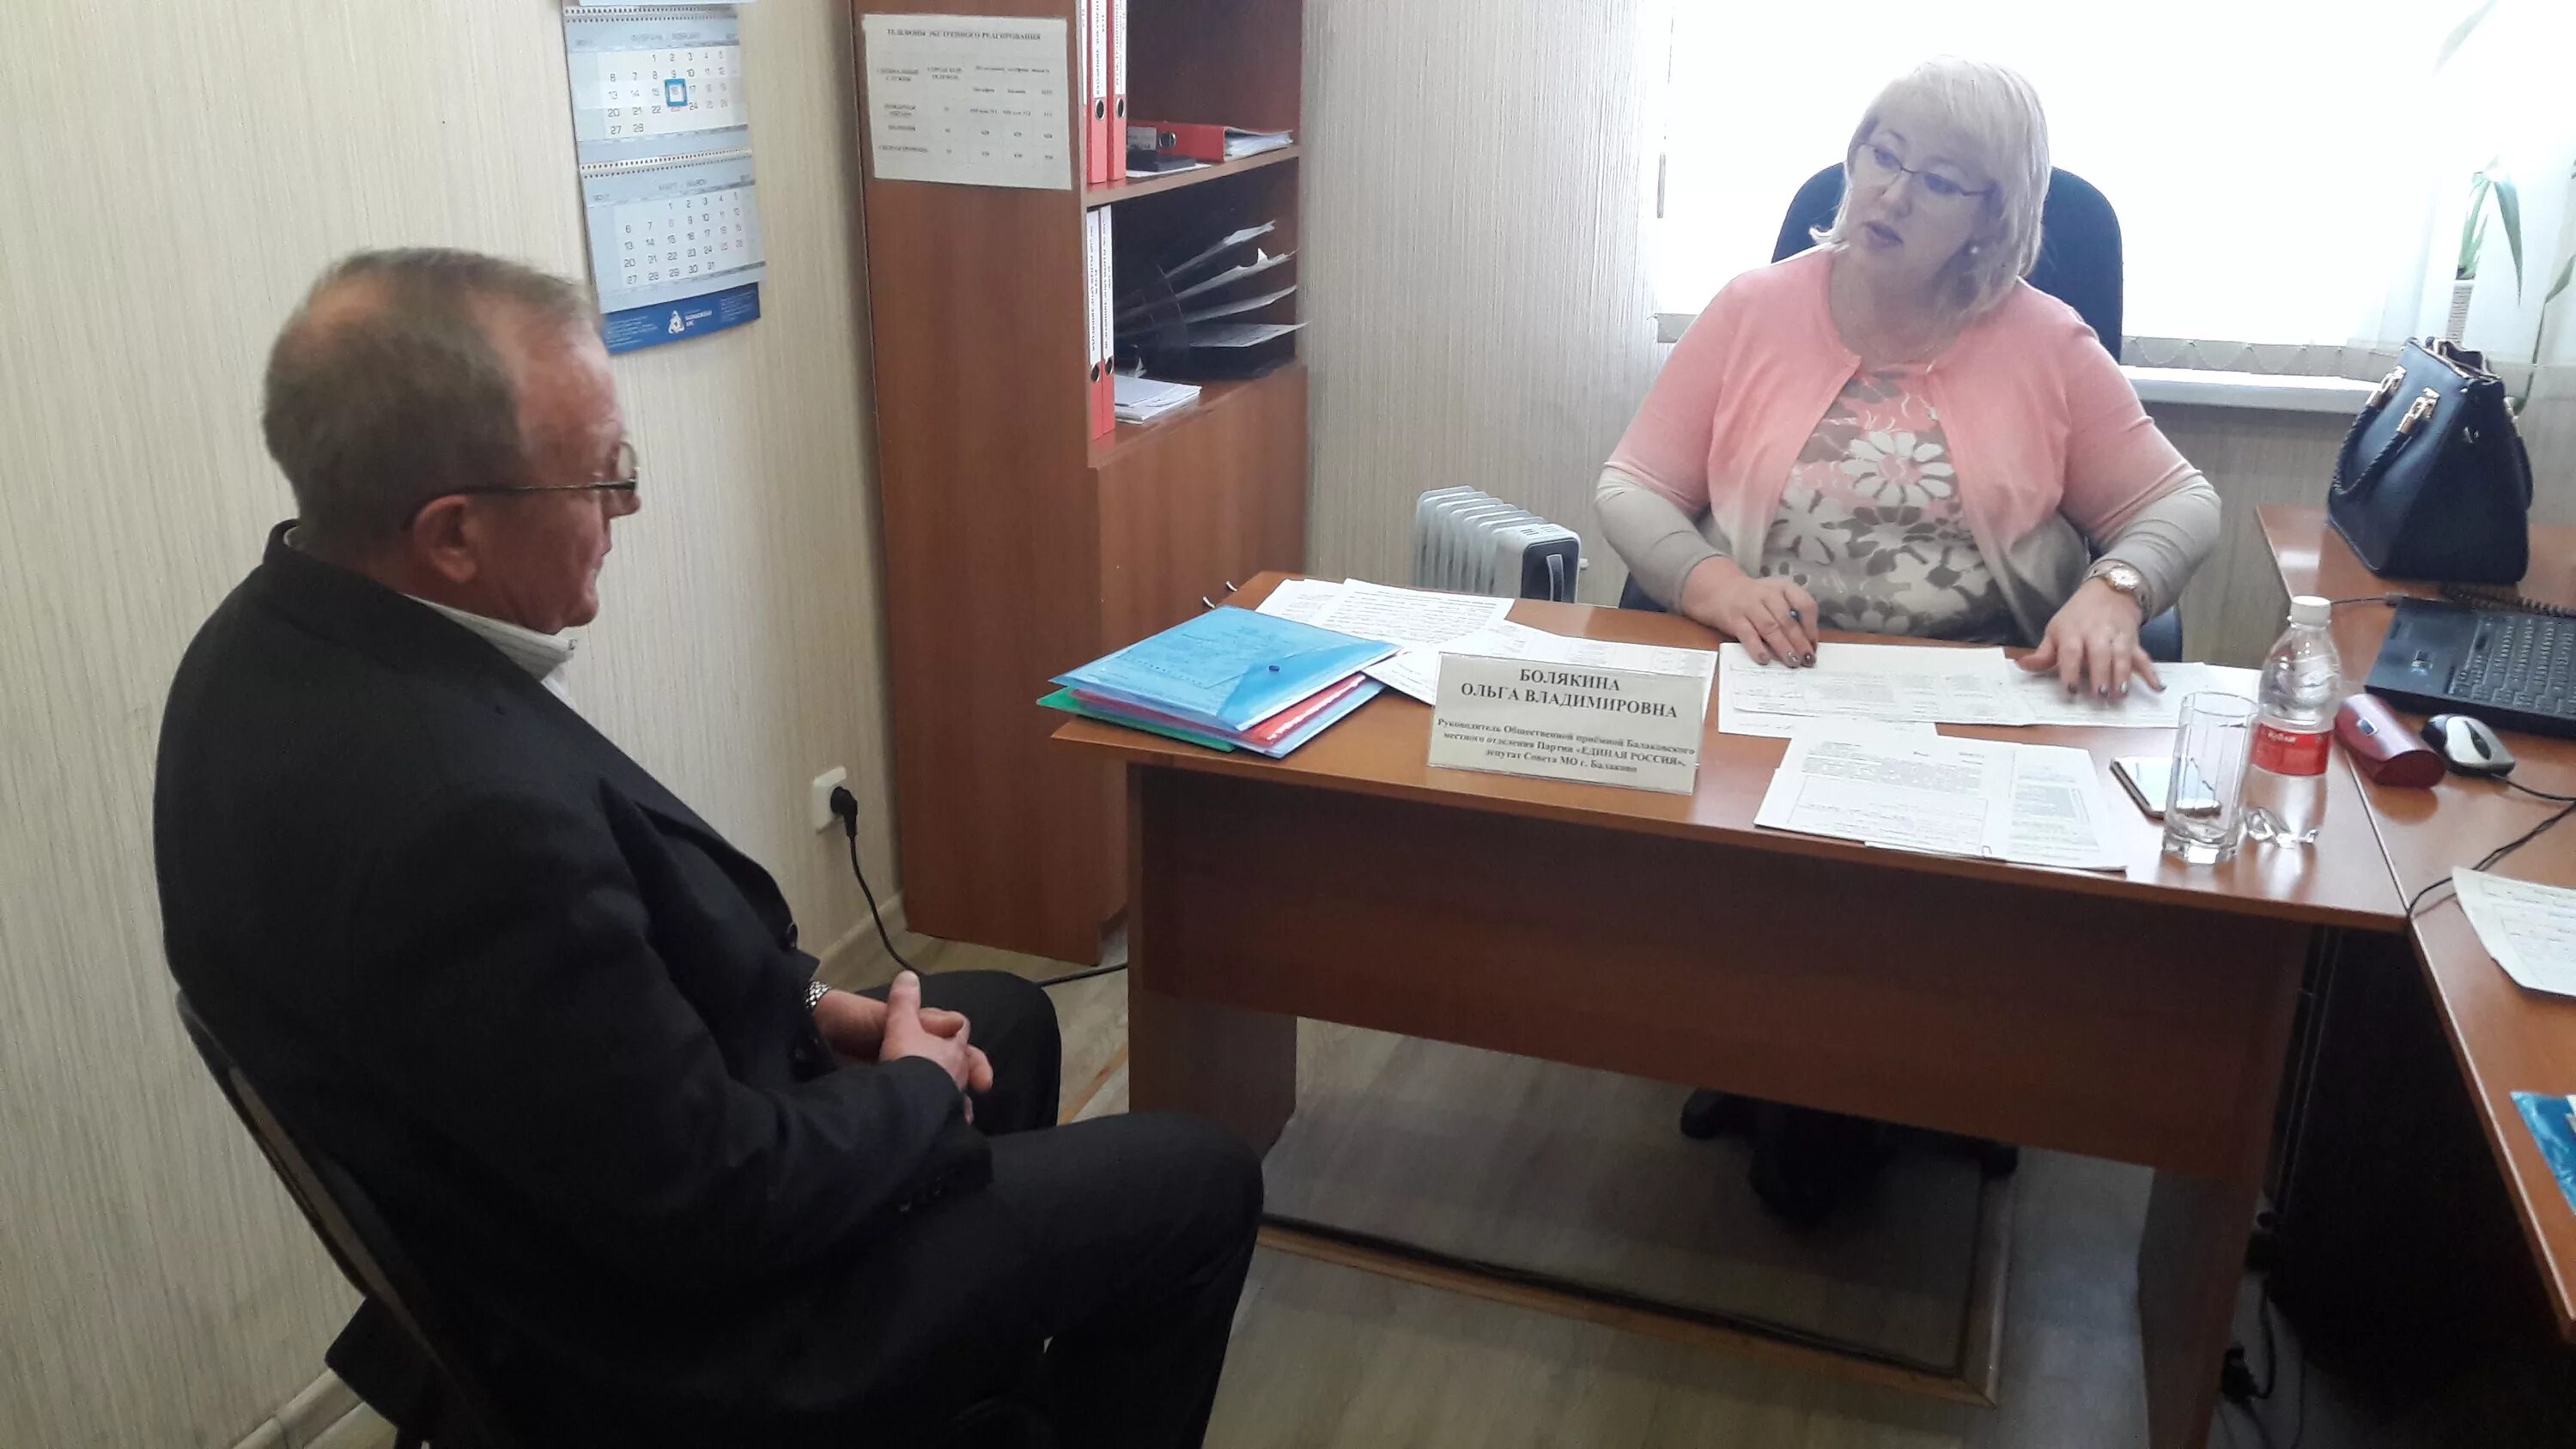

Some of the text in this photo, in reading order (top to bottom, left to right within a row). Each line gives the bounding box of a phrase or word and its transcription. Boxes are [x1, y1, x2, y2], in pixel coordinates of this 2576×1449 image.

[669, 53, 675, 62] 2
[688, 52, 694, 61] 3
[632, 72, 638, 81] 7
[652, 70, 658, 80] 8
[686, 69, 695, 77] 10
[608, 91, 618, 100] 13
[689, 85, 696, 94] 17
[607, 108, 620, 118] 20
[632, 106, 642, 116] 21
[651, 105, 662, 114] 22
[689, 101, 699, 111] 24
[610, 123, 644, 136] 27 28
[686, 199, 691, 209] 2
[702, 197, 708, 206] 3
[625, 224, 632, 233] 6
[647, 221, 653, 231] 7
[687, 215, 693, 225] 9
[702, 213, 709, 222] 10
[624, 241, 634, 251] 13
[646, 238, 655, 246] 14
[667, 234, 677, 245] 15
[687, 232, 696, 240] 16
[704, 228, 711, 238] 17
[623, 258, 635, 268] 20
[647, 255, 658, 264] 21
[667, 252, 678, 261] 22
[687, 248, 696, 258] 23
[703, 246, 714, 255] 24
[627, 261, 715, 285] 27 28 29 30 31
[1519, 668, 1620, 692] БОЛЯКИНА
[1461, 682, 1678, 718] ОЛЬГА ВЛАДИМИРОВНА
[1437, 718, 1696, 755] Руководитель Общественной приёмной Балаковского
[1443, 731, 1485, 743] местного
[1486, 737, 1534, 749] отделения
[1576, 746, 1627, 760] «ЕДИНАЯ
[1630, 752, 1686, 767] РОССИЯ»,
[1485, 749, 1522, 760] депутат
[1523, 751, 1557, 763] Совета
[1560, 755, 1578, 766] МО
[1590, 760, 1637, 773] Балаково
